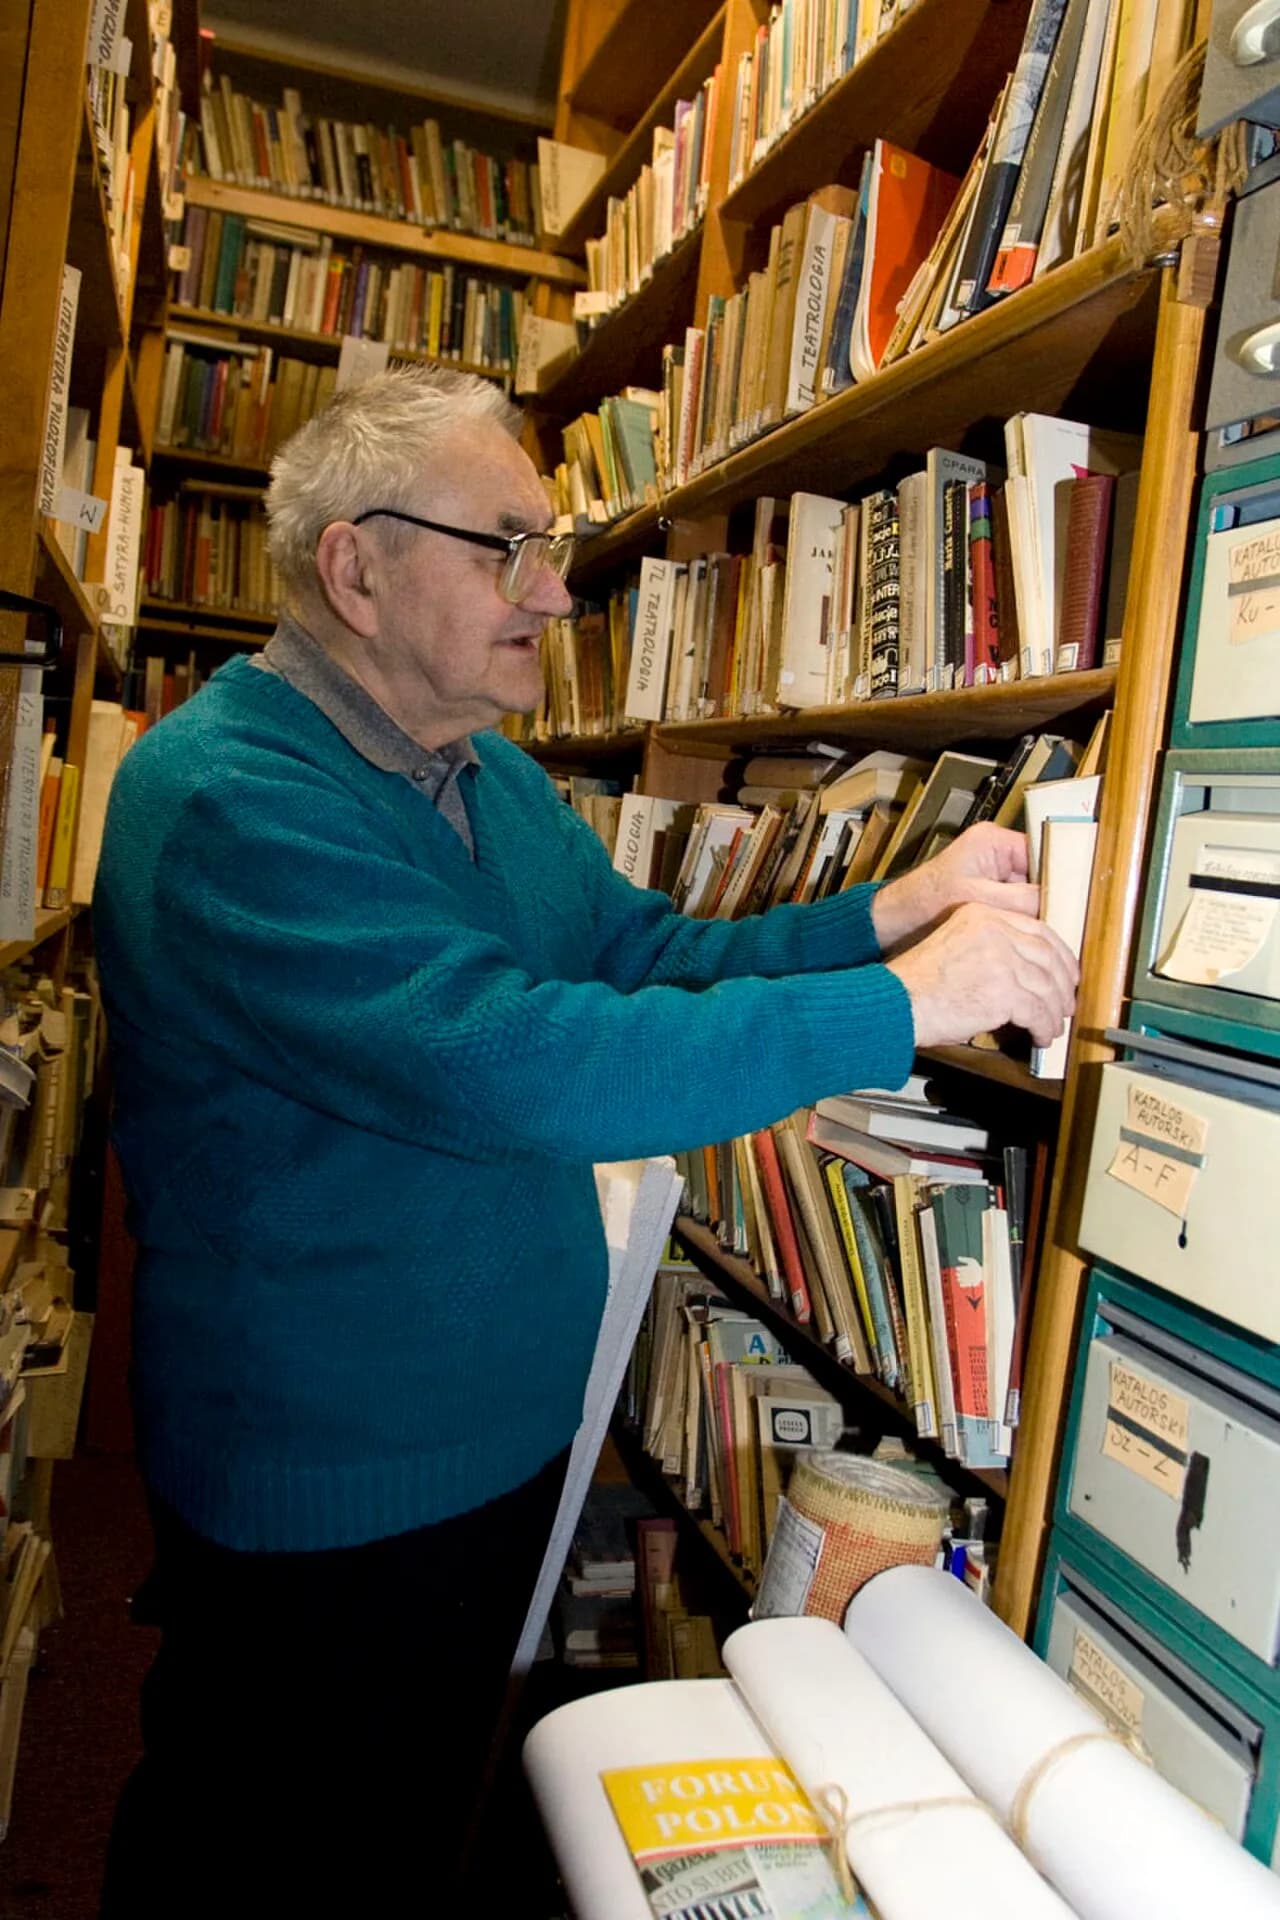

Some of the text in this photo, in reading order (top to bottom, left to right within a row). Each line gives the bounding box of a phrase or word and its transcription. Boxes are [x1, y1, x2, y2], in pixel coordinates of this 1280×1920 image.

[801, 244, 826, 369] TEATROLOGIA
[50, 297, 74, 398] LITERATURA
[635, 593, 660, 692] TEATROLOGIA
[1137, 1109, 1194, 1147] AUTORSKI
[749, 1334, 767, 1354] A
[1116, 1390, 1184, 1439] AUTORSKI
